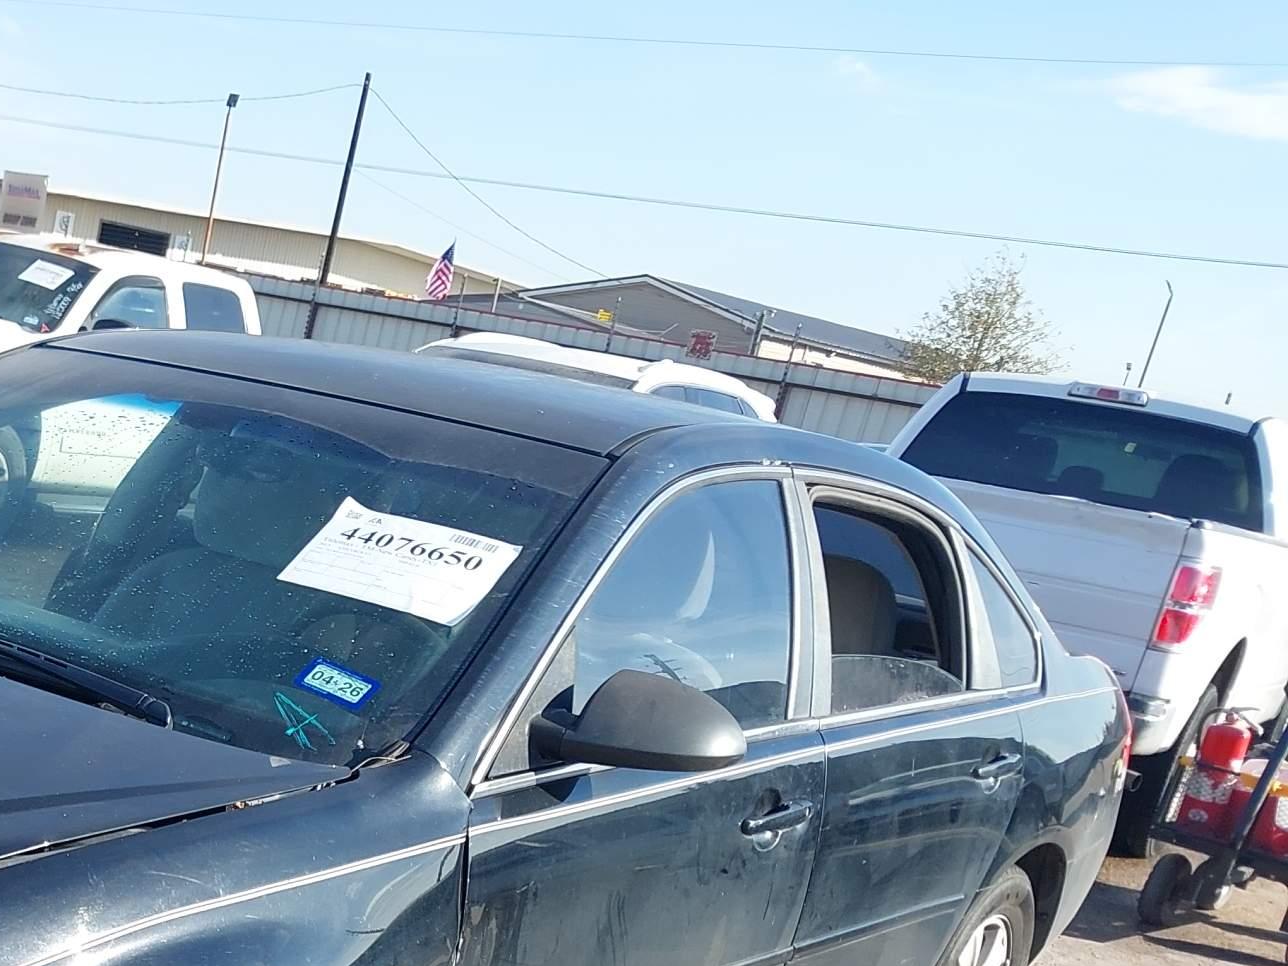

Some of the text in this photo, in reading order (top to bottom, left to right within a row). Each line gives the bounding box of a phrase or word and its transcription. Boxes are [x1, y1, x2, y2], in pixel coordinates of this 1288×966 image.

[339, 526, 484, 572] 44076650
[311, 670, 364, 698] 04 26
